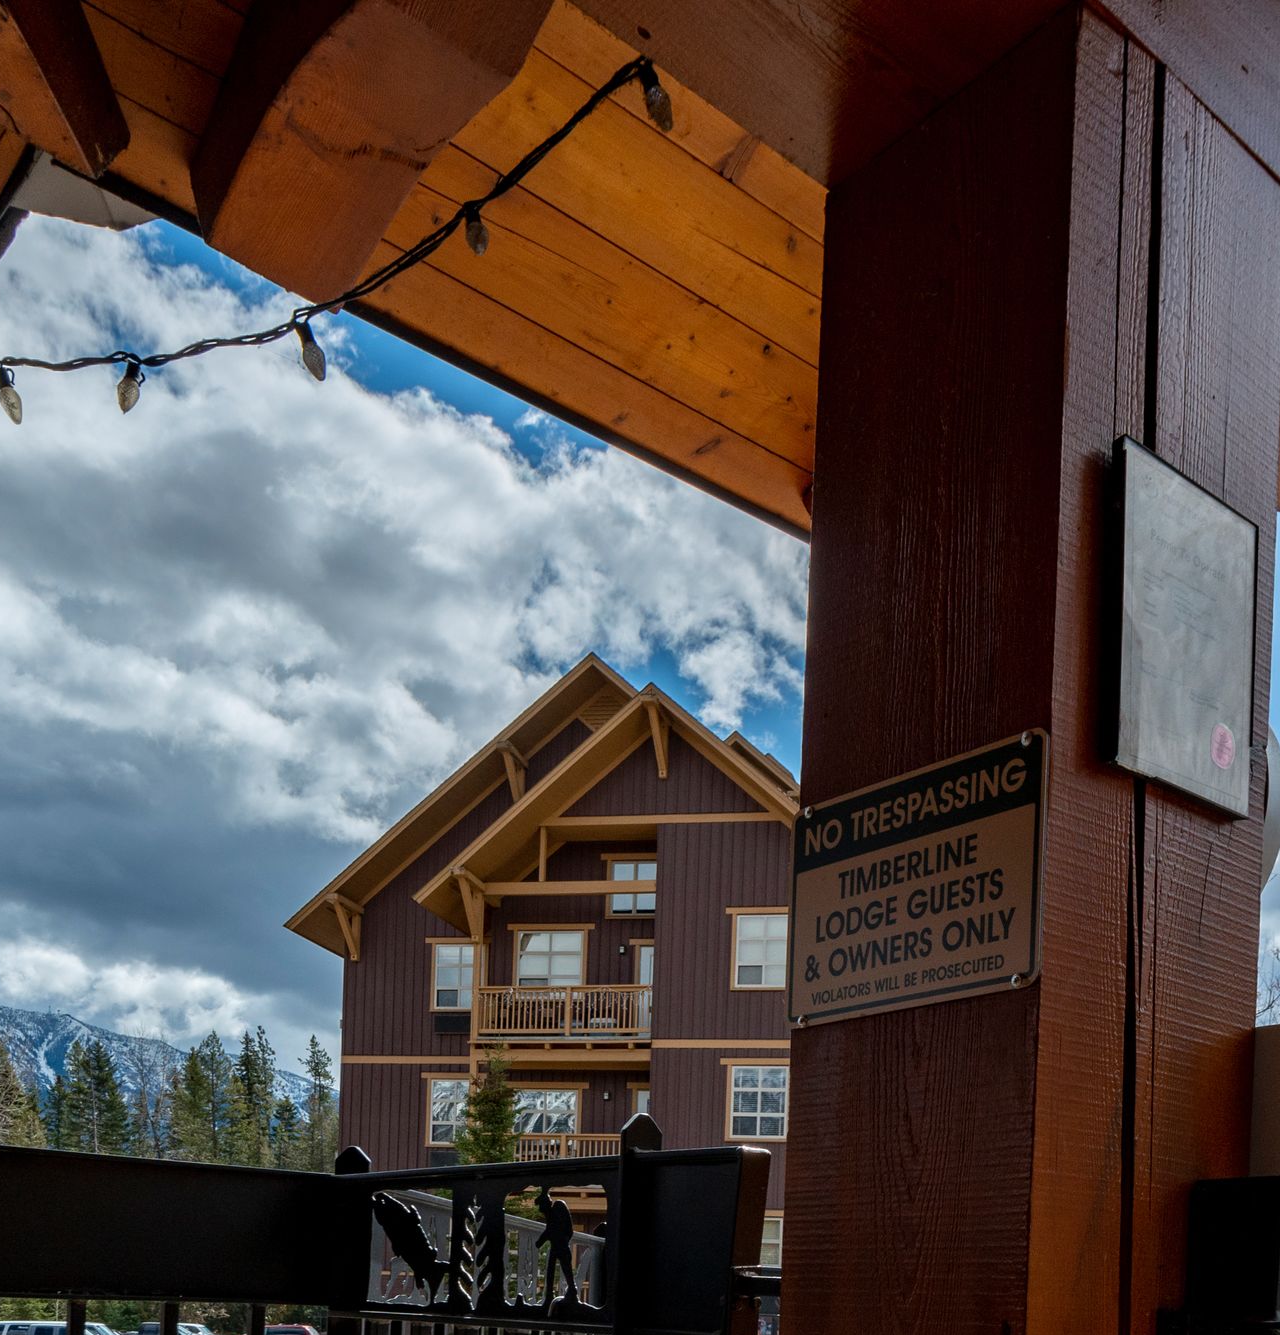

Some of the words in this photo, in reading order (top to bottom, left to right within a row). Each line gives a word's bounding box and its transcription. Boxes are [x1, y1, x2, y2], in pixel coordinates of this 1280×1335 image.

[804, 819, 843, 857] NO
[851, 758, 1027, 841] TRESPASSING
[838, 833, 978, 899] TIMBERLINE
[815, 896, 897, 943] LODGE
[906, 868, 1004, 920] GUESTS
[804, 955, 820, 983] &
[828, 927, 933, 977] OWNERS
[942, 907, 1016, 952] ONLY
[811, 981, 871, 1006] VIOLATORS
[874, 975, 900, 993] WILL
[904, 973, 917, 987] BE
[922, 954, 1005, 984] PROSECUTED
